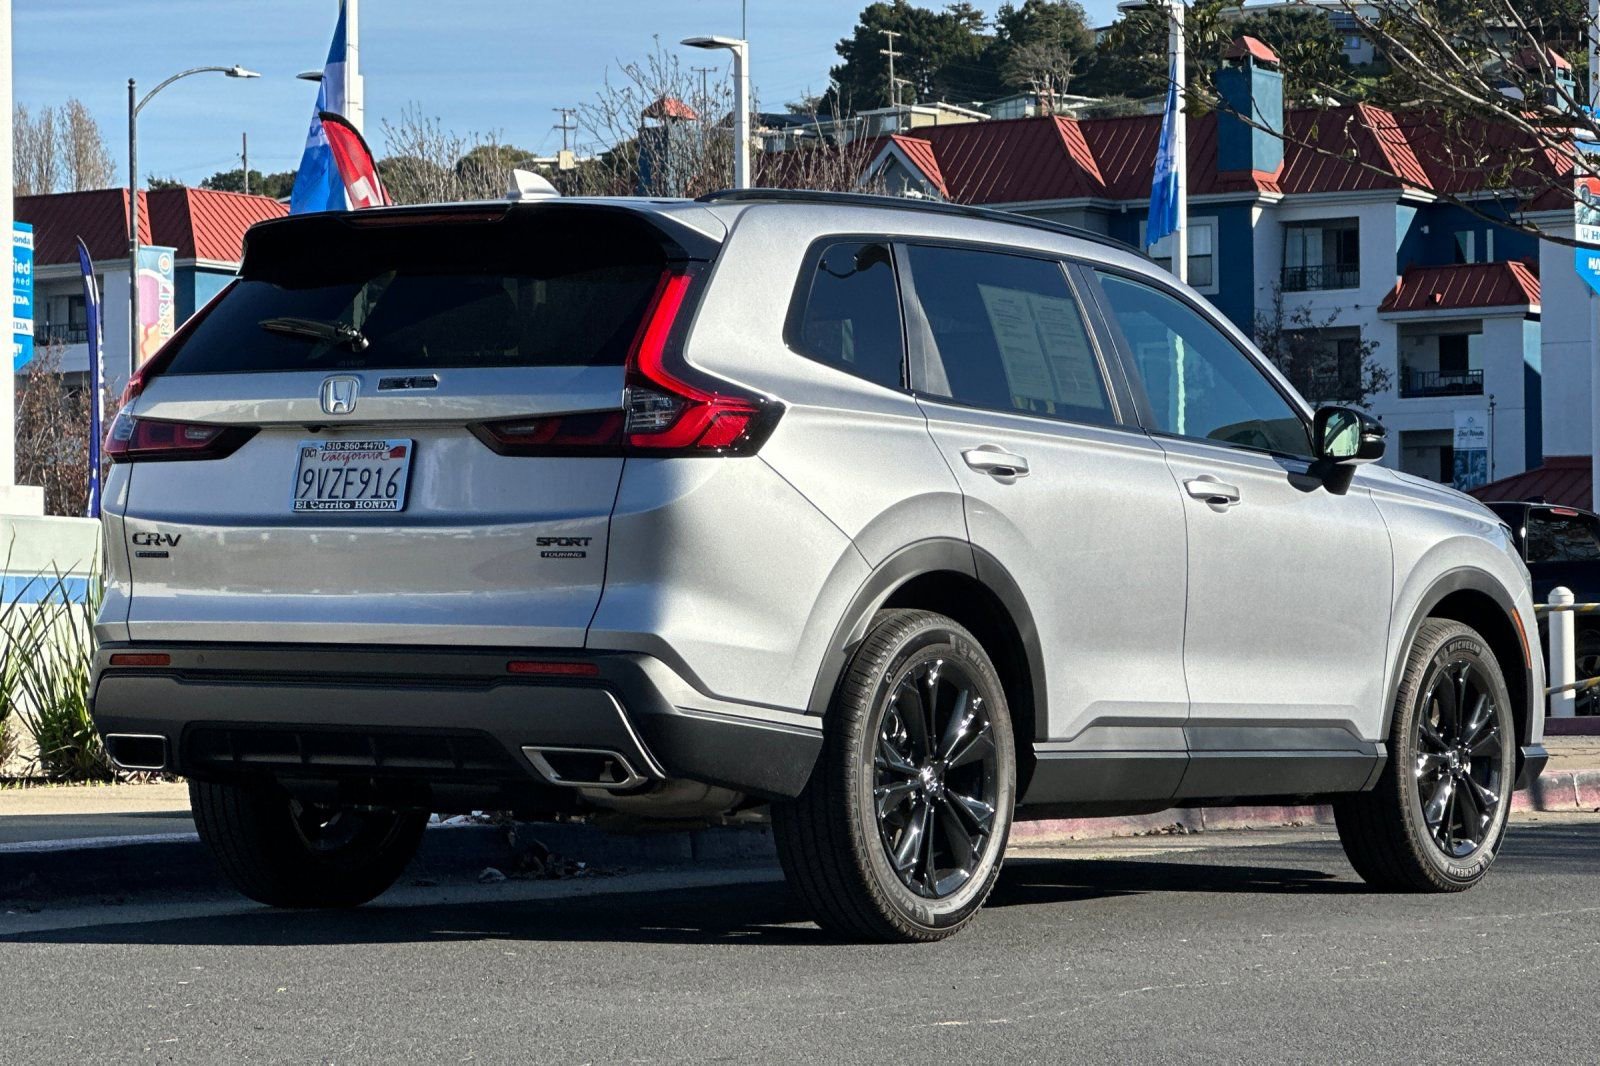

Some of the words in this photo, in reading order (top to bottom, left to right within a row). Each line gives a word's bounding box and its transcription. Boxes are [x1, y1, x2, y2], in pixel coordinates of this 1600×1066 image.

[14, 257, 30, 275] ied
[326, 442, 385, 450] 510-860-4470
[321, 451, 389, 466] California
[300, 467, 402, 499] 9VZF916
[295, 501, 307, 509] El
[310, 501, 351, 509] Cerrito
[354, 501, 396, 509] HONDA
[132, 532, 181, 547] CR-V
[536, 537, 592, 546] SPORT
